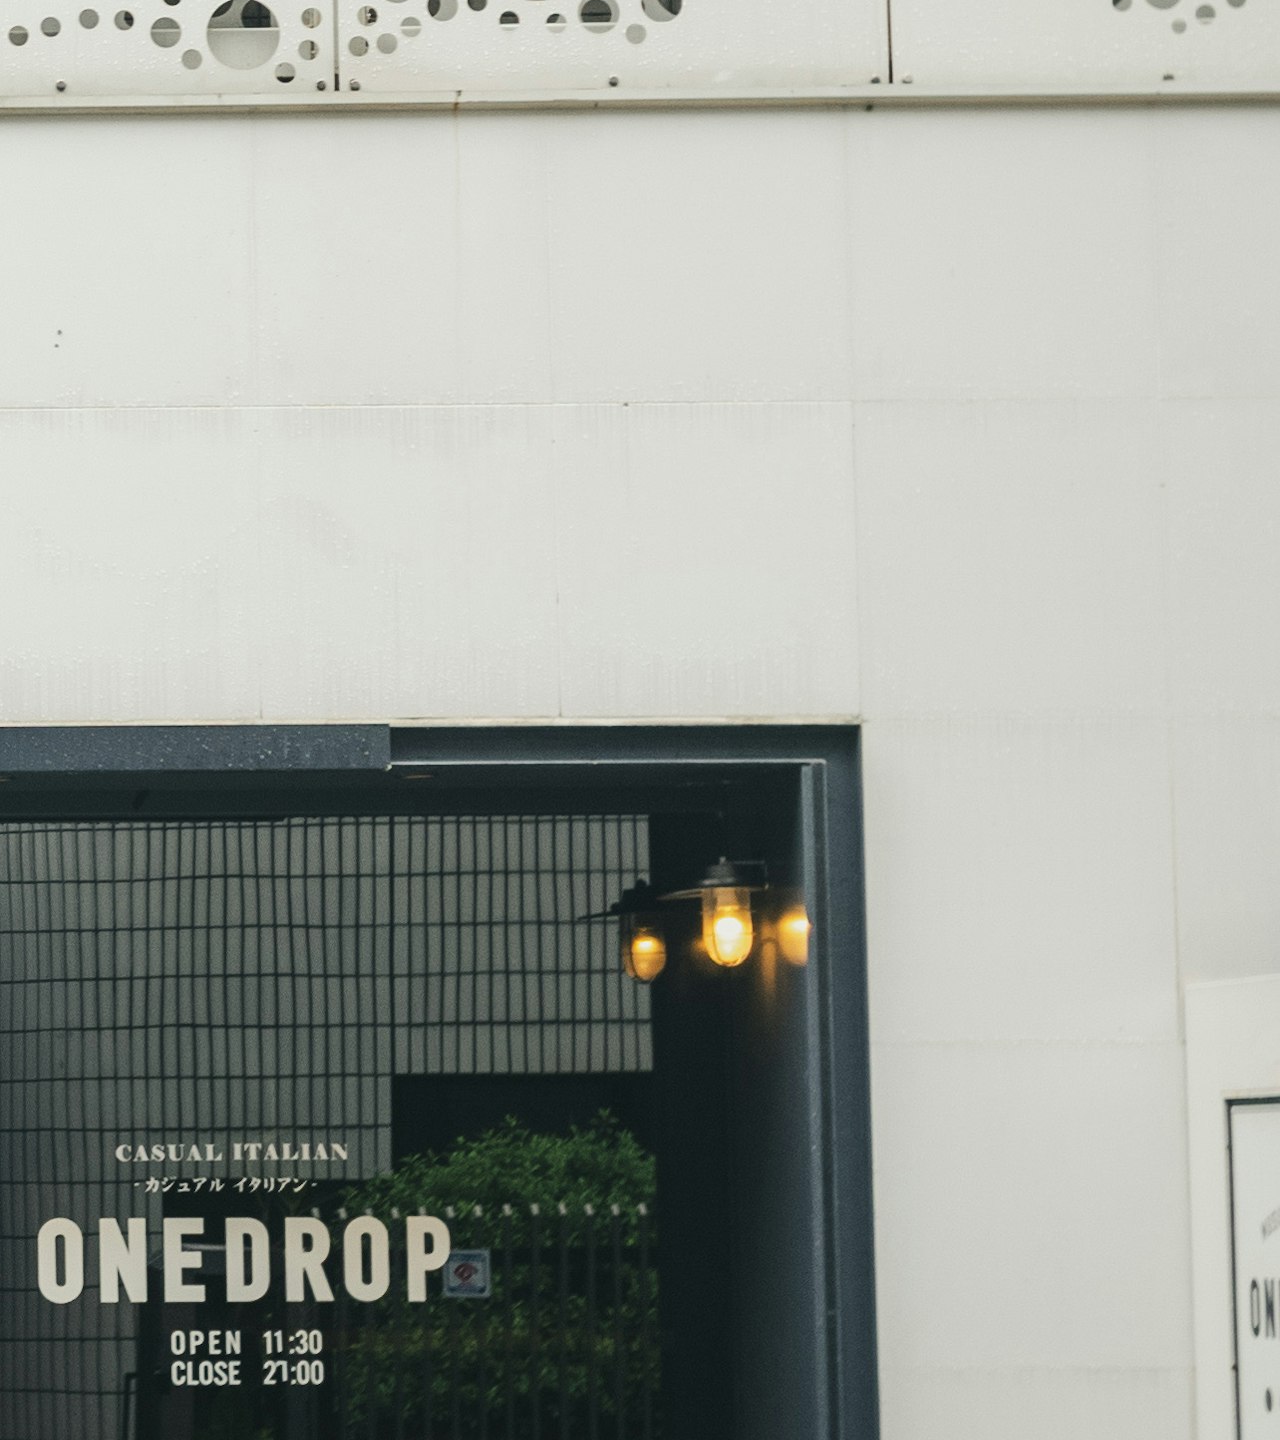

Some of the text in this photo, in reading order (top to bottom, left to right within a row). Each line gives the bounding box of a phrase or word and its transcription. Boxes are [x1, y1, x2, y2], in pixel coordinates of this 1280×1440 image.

[115, 1143, 349, 1163] CASUAL ITALIAN
[170, 1329, 242, 1356] OPEN
[170, 1360, 242, 1386] CLOSE
